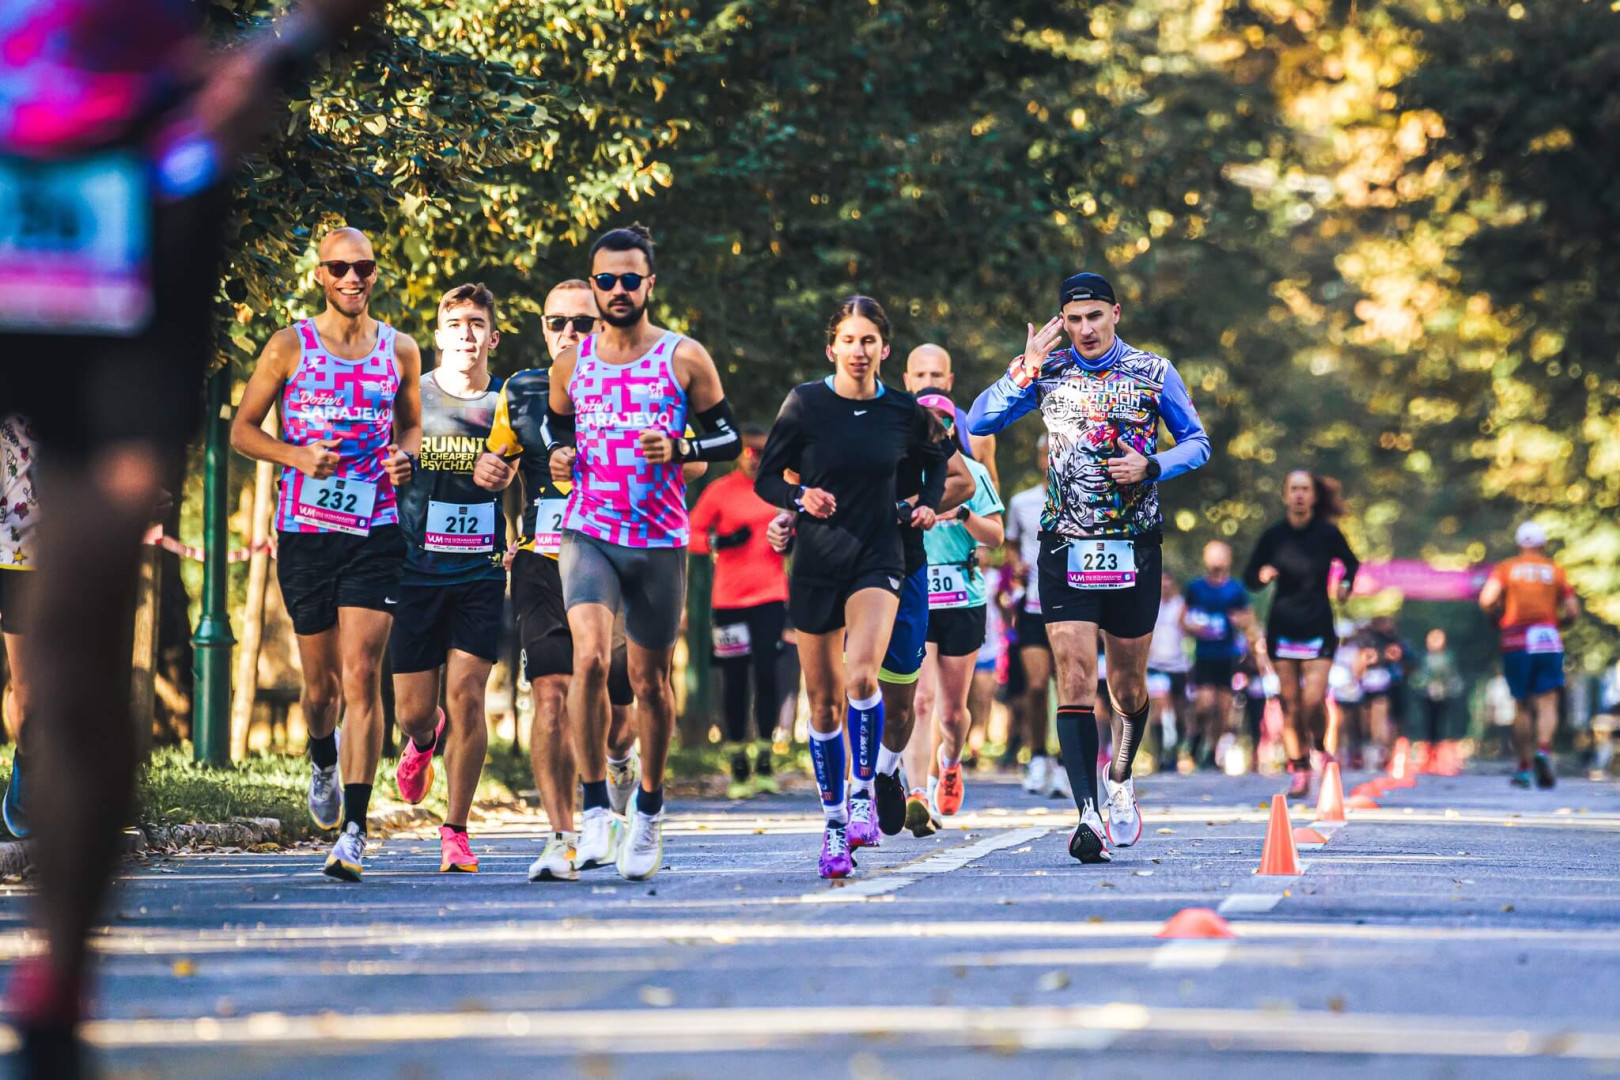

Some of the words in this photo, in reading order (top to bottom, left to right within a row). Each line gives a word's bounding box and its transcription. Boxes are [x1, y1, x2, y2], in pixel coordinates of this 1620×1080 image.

[299, 405, 390, 420] SARAJEVO
[578, 411, 670, 427] SARAJEVO
[420, 436, 487, 453] RUNNI
[430, 453, 474, 461] CHEAPER
[421, 460, 474, 471] PSYCHIA
[317, 488, 357, 513] 232
[445, 516, 478, 533] 212
[552, 513, 562, 532] 2
[427, 534, 443, 543] VUM
[1083, 553, 1118, 570] 223
[928, 576, 953, 592] 30
[1069, 573, 1085, 582] VUM
[1124, 573, 1131, 581] 6
